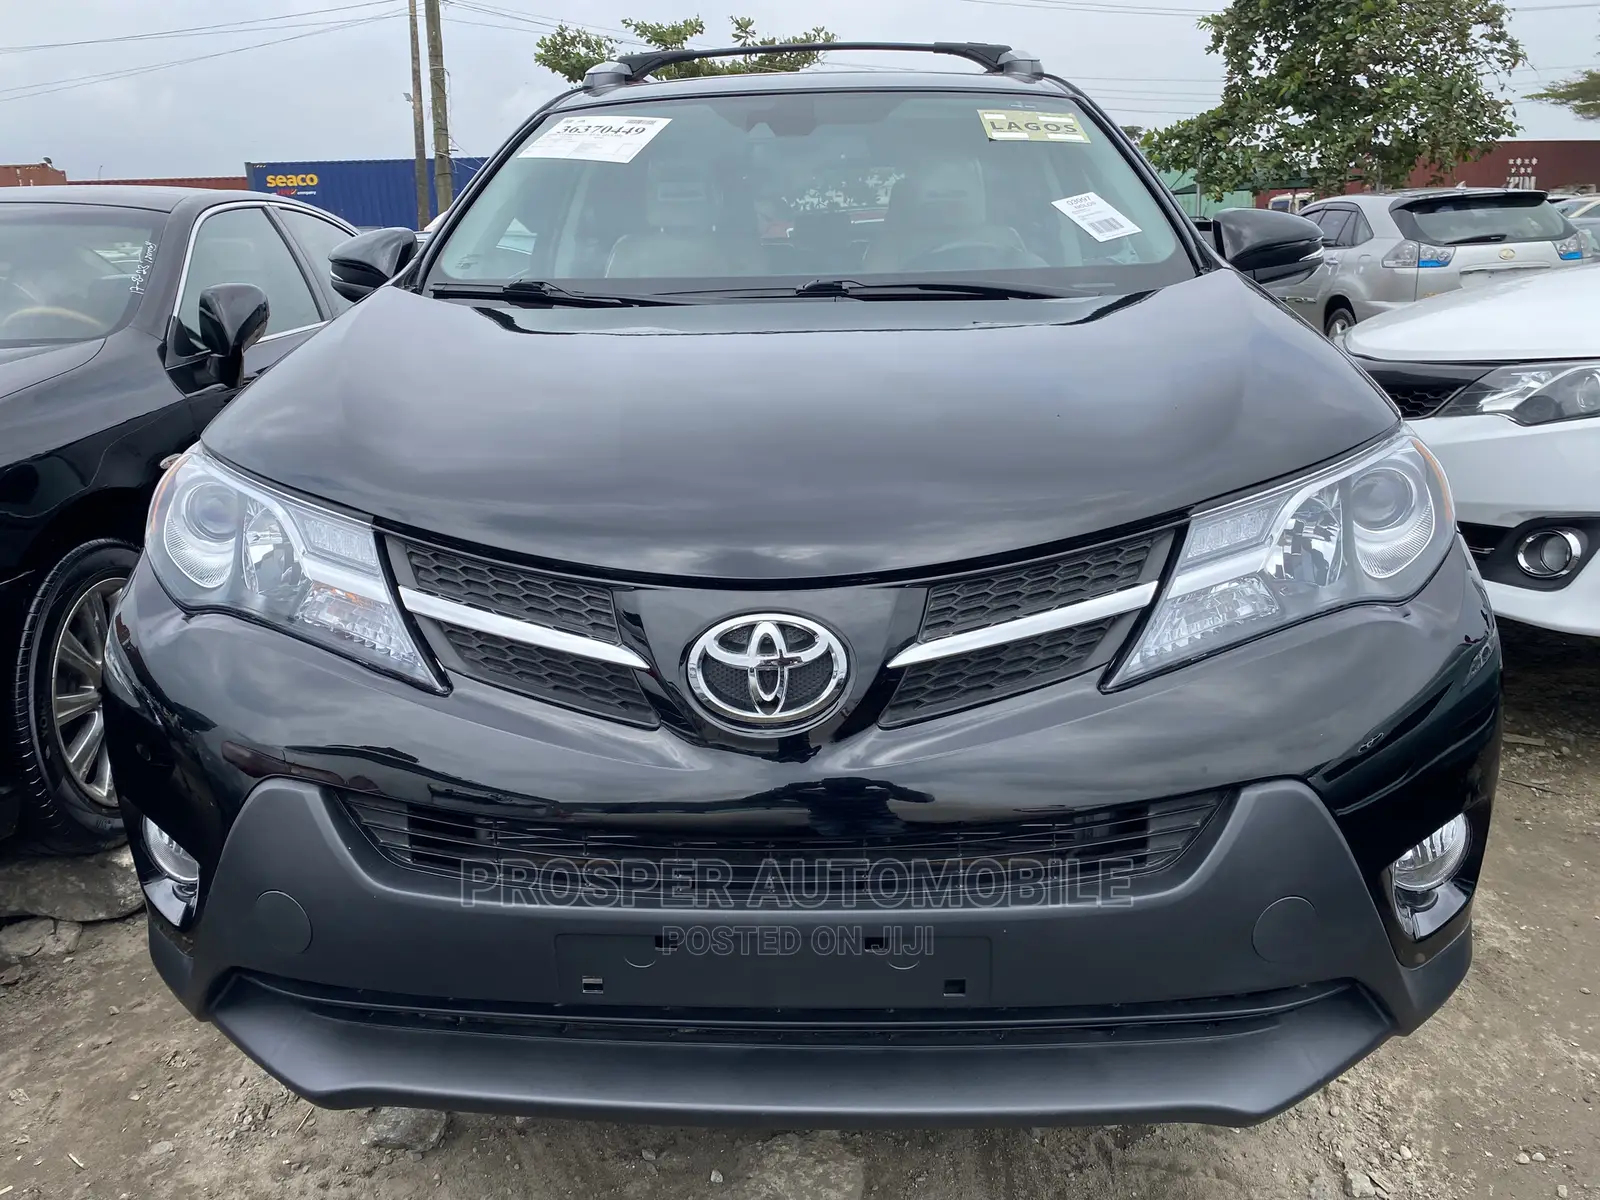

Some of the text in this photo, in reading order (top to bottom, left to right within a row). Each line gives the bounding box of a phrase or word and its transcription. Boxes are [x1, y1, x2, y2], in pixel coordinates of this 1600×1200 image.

[556, 125, 647, 136] 36370449
[989, 121, 1078, 133] LAGOS
[265, 173, 319, 188] seaco
